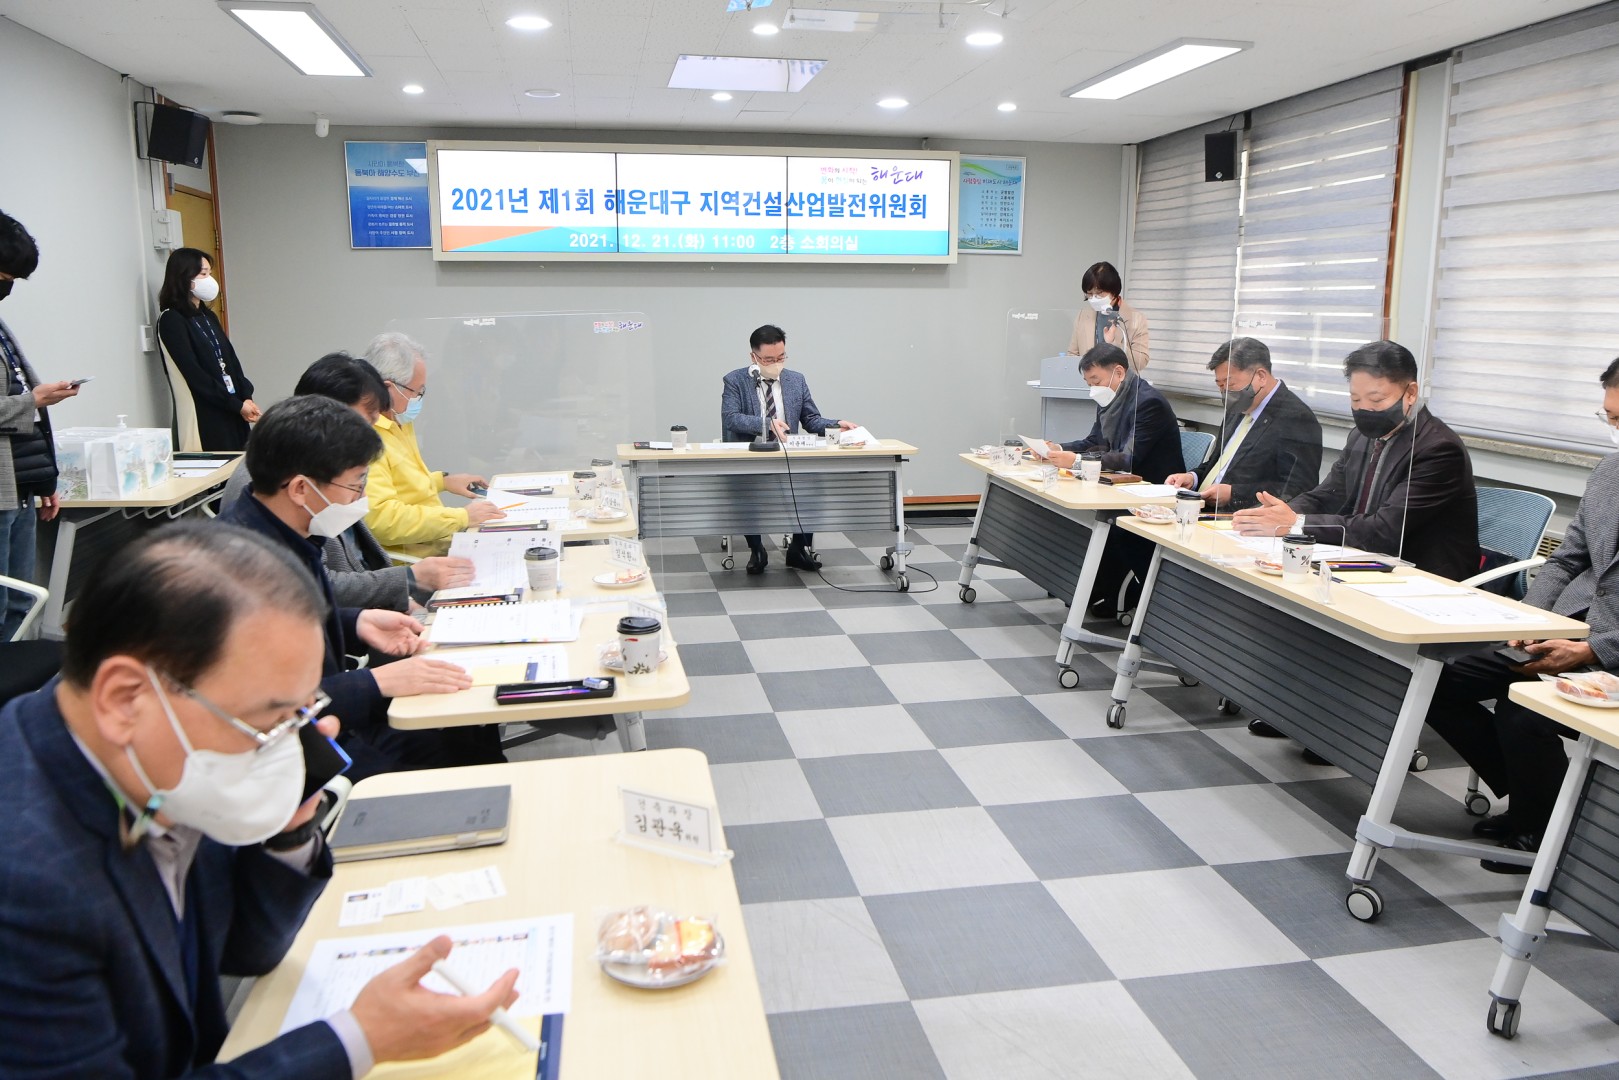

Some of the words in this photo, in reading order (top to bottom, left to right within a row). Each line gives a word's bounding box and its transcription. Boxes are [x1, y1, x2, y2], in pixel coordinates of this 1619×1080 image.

[871, 166, 923, 185] 해운대
[451, 187, 529, 214] 2021년
[538, 188, 594, 214] 제1회
[603, 189, 691, 216] 해운대구
[699, 190, 927, 219] 지역건설산업발전위원회
[569, 233, 614, 248] 2021.
[623, 233, 647, 248] 12.
[652, 233, 705, 250] 21.(화)
[712, 235, 755, 249] 11:00
[770, 235, 795, 250] 2층
[800, 235, 859, 251] 소회의실
